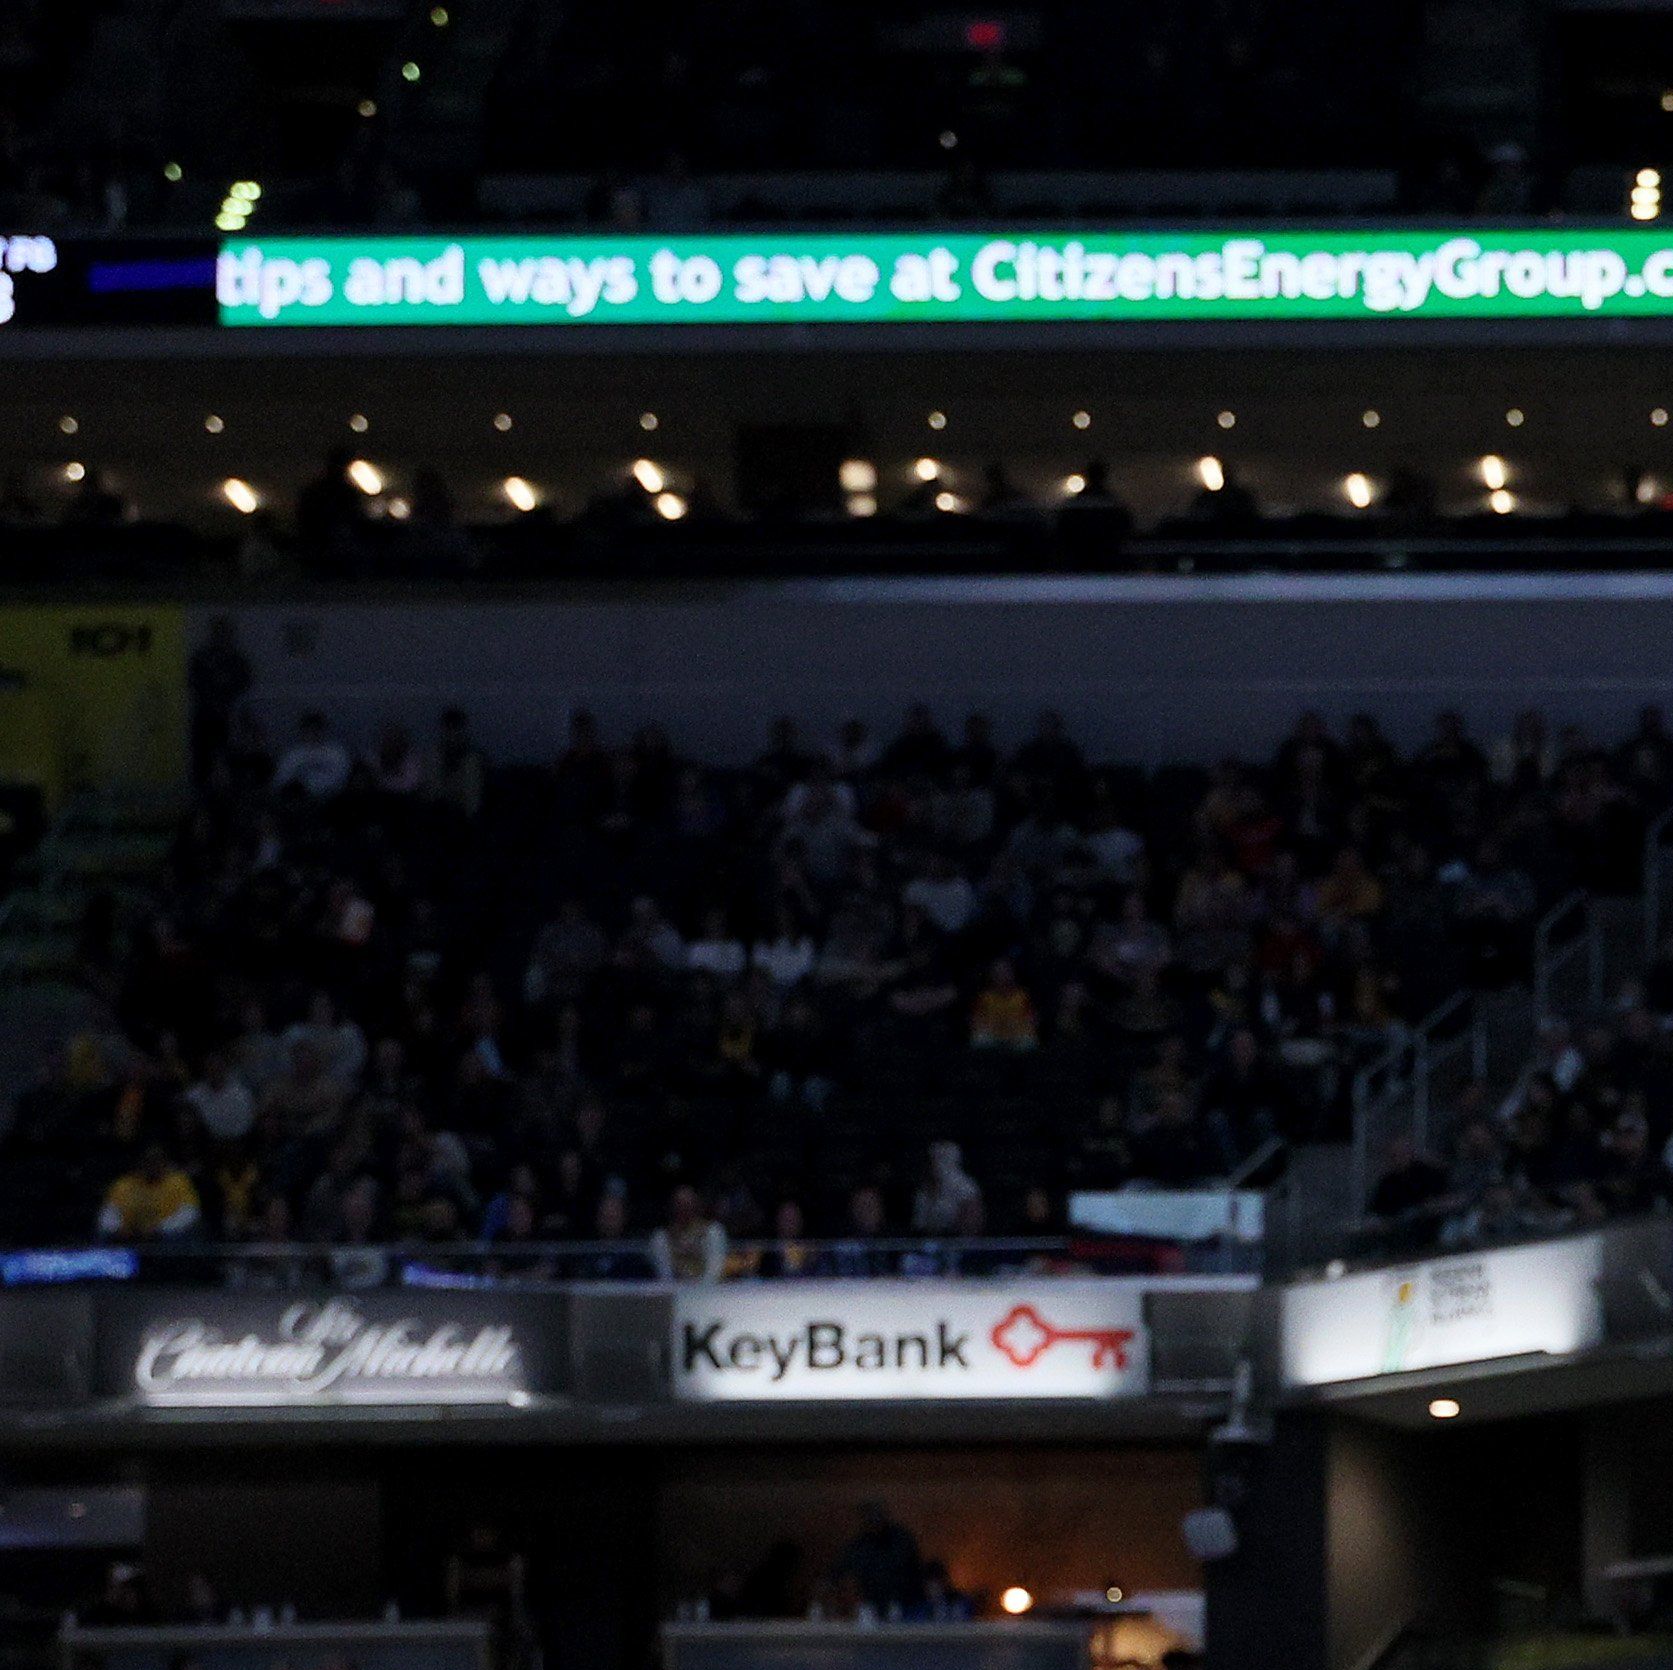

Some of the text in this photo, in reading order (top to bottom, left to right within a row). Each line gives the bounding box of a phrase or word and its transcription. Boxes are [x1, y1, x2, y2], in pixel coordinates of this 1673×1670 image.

[216, 246, 332, 319] tips
[343, 244, 465, 306] and
[478, 253, 638, 318] ways
[650, 247, 722, 304] to
[733, 250, 880, 305] save
[889, 246, 961, 304] at
[681, 1317, 970, 1382] KeyBank
